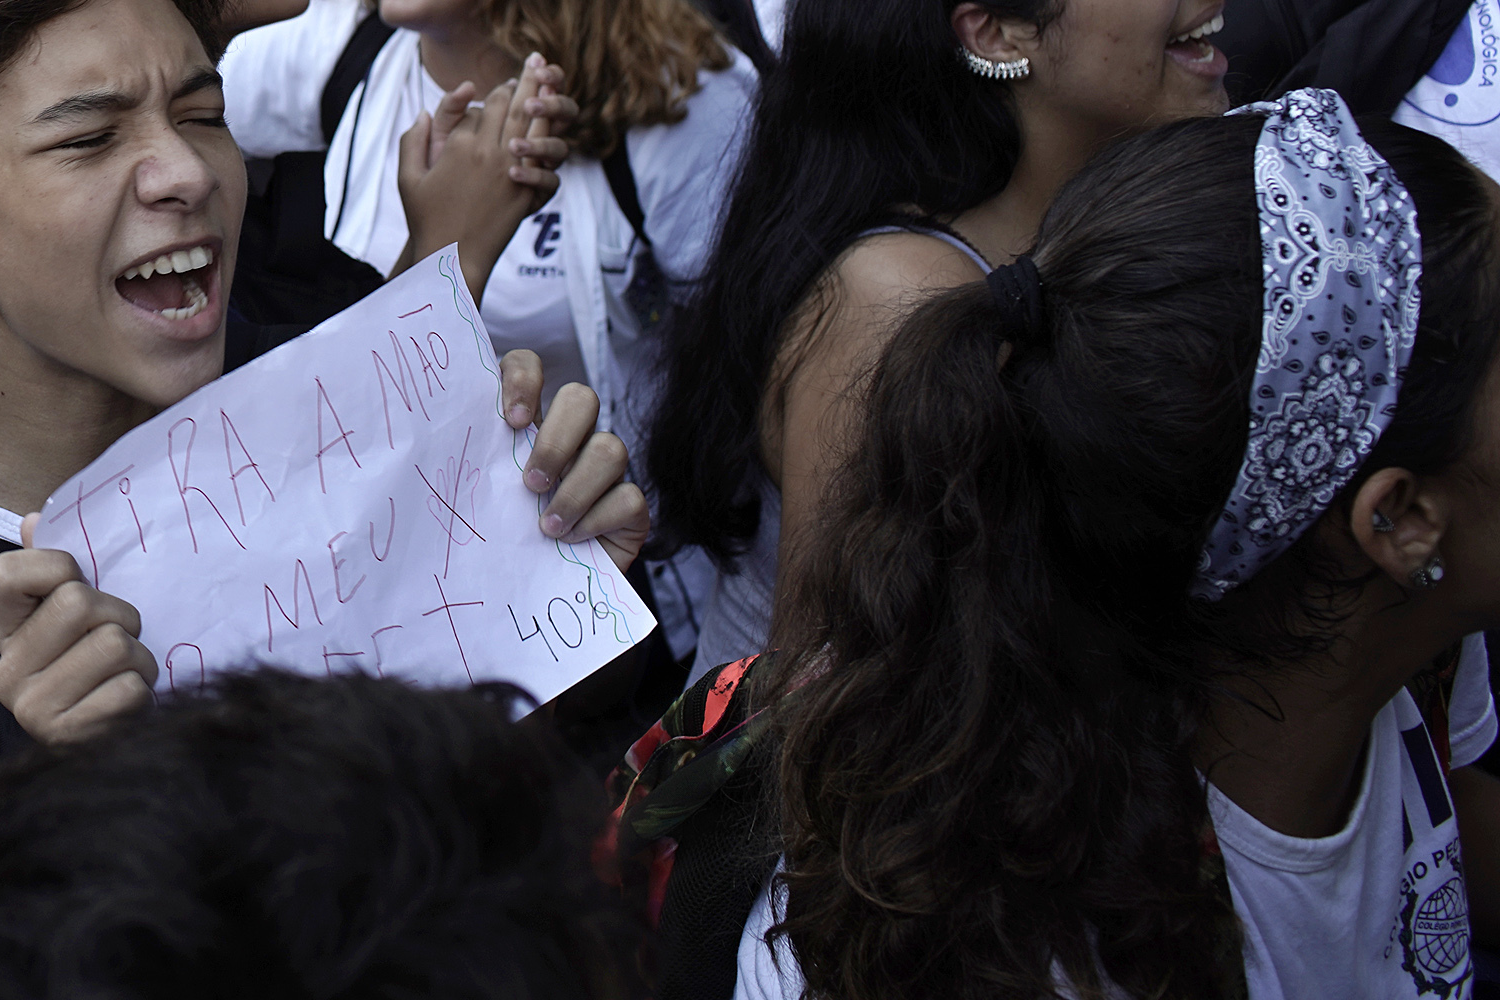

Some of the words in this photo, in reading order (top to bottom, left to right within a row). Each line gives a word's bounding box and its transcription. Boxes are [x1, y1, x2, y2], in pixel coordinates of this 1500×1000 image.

[314, 375, 362, 494] A
[371, 303, 449, 450] MÃO
[264, 496, 395, 653] MEU
[507, 575, 610, 663] 40%
